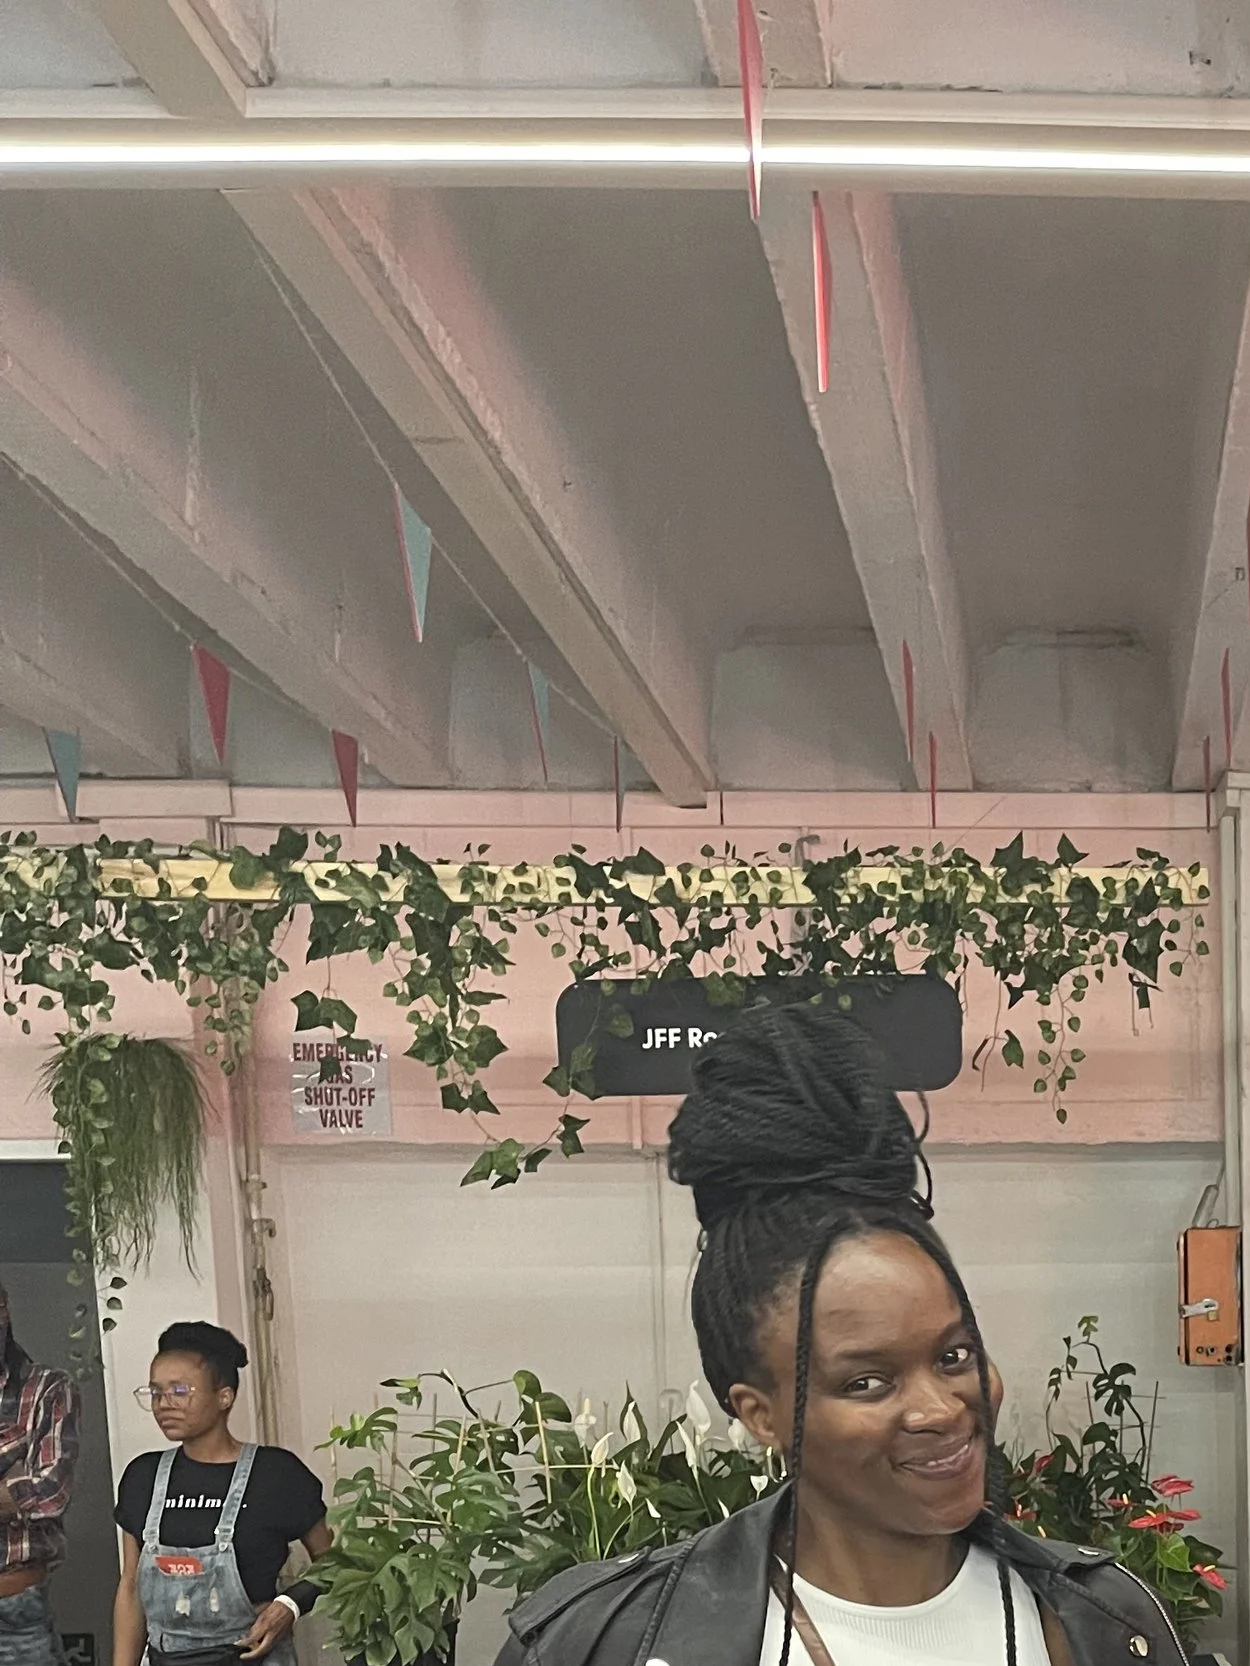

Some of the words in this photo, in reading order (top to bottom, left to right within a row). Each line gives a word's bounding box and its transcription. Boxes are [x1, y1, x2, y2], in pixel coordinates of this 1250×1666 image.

[641, 1027, 682, 1050] JFF
[304, 1086, 376, 1107] SHUT-OFF
[319, 1109, 364, 1129] VALVE
